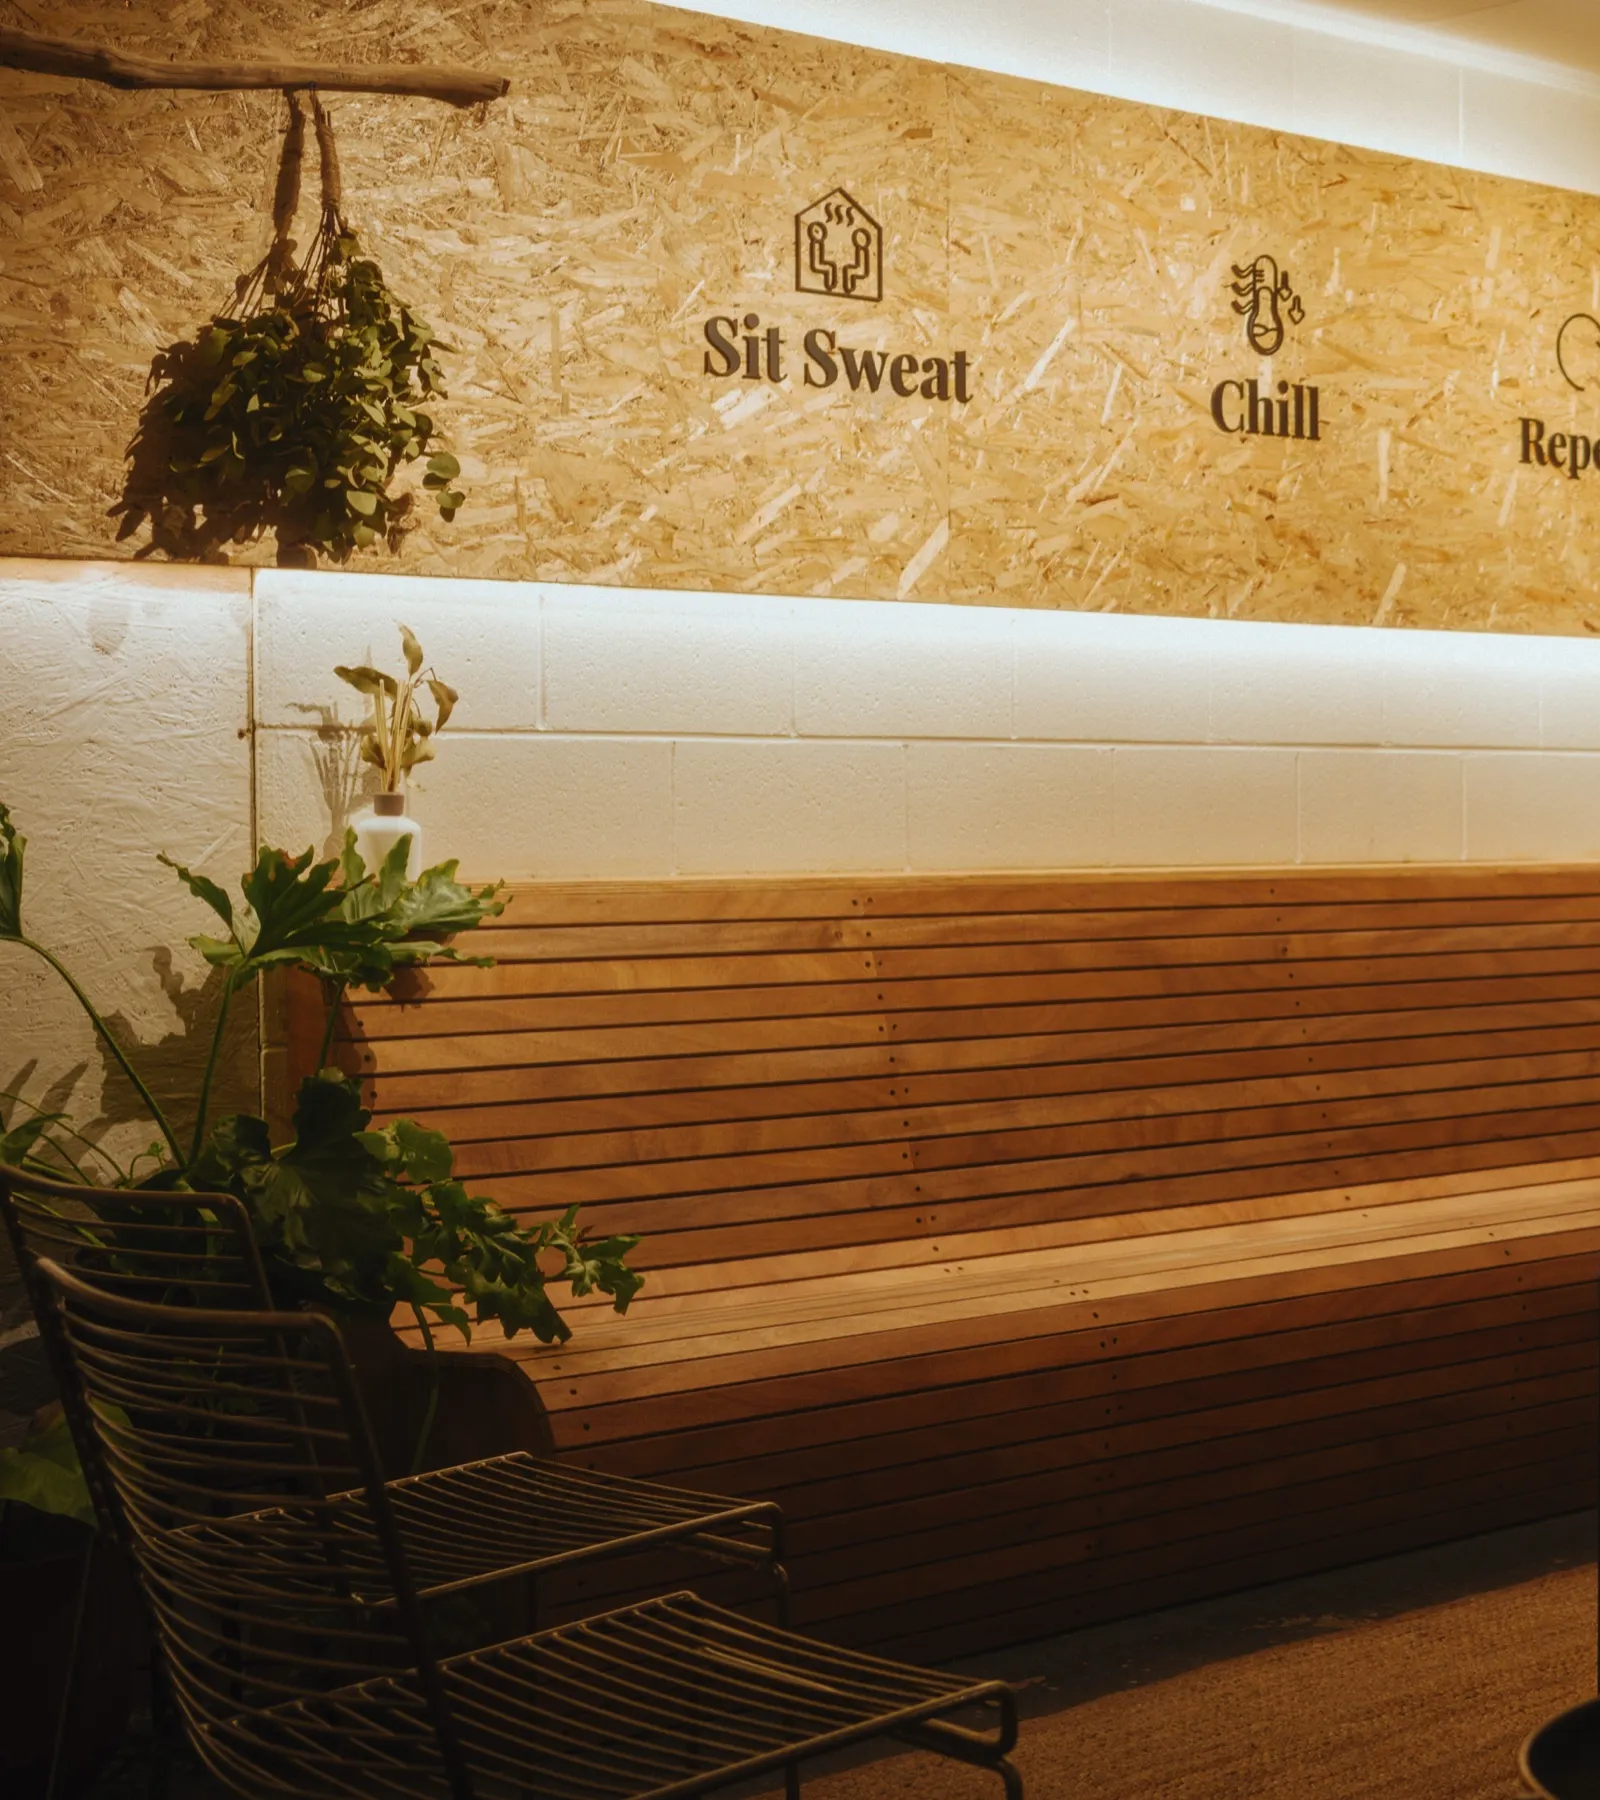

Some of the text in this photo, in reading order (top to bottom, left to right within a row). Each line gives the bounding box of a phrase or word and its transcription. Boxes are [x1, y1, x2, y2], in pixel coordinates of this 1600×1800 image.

[703, 313, 974, 404] Sit Sweat
[1210, 378, 1321, 441] Chill
